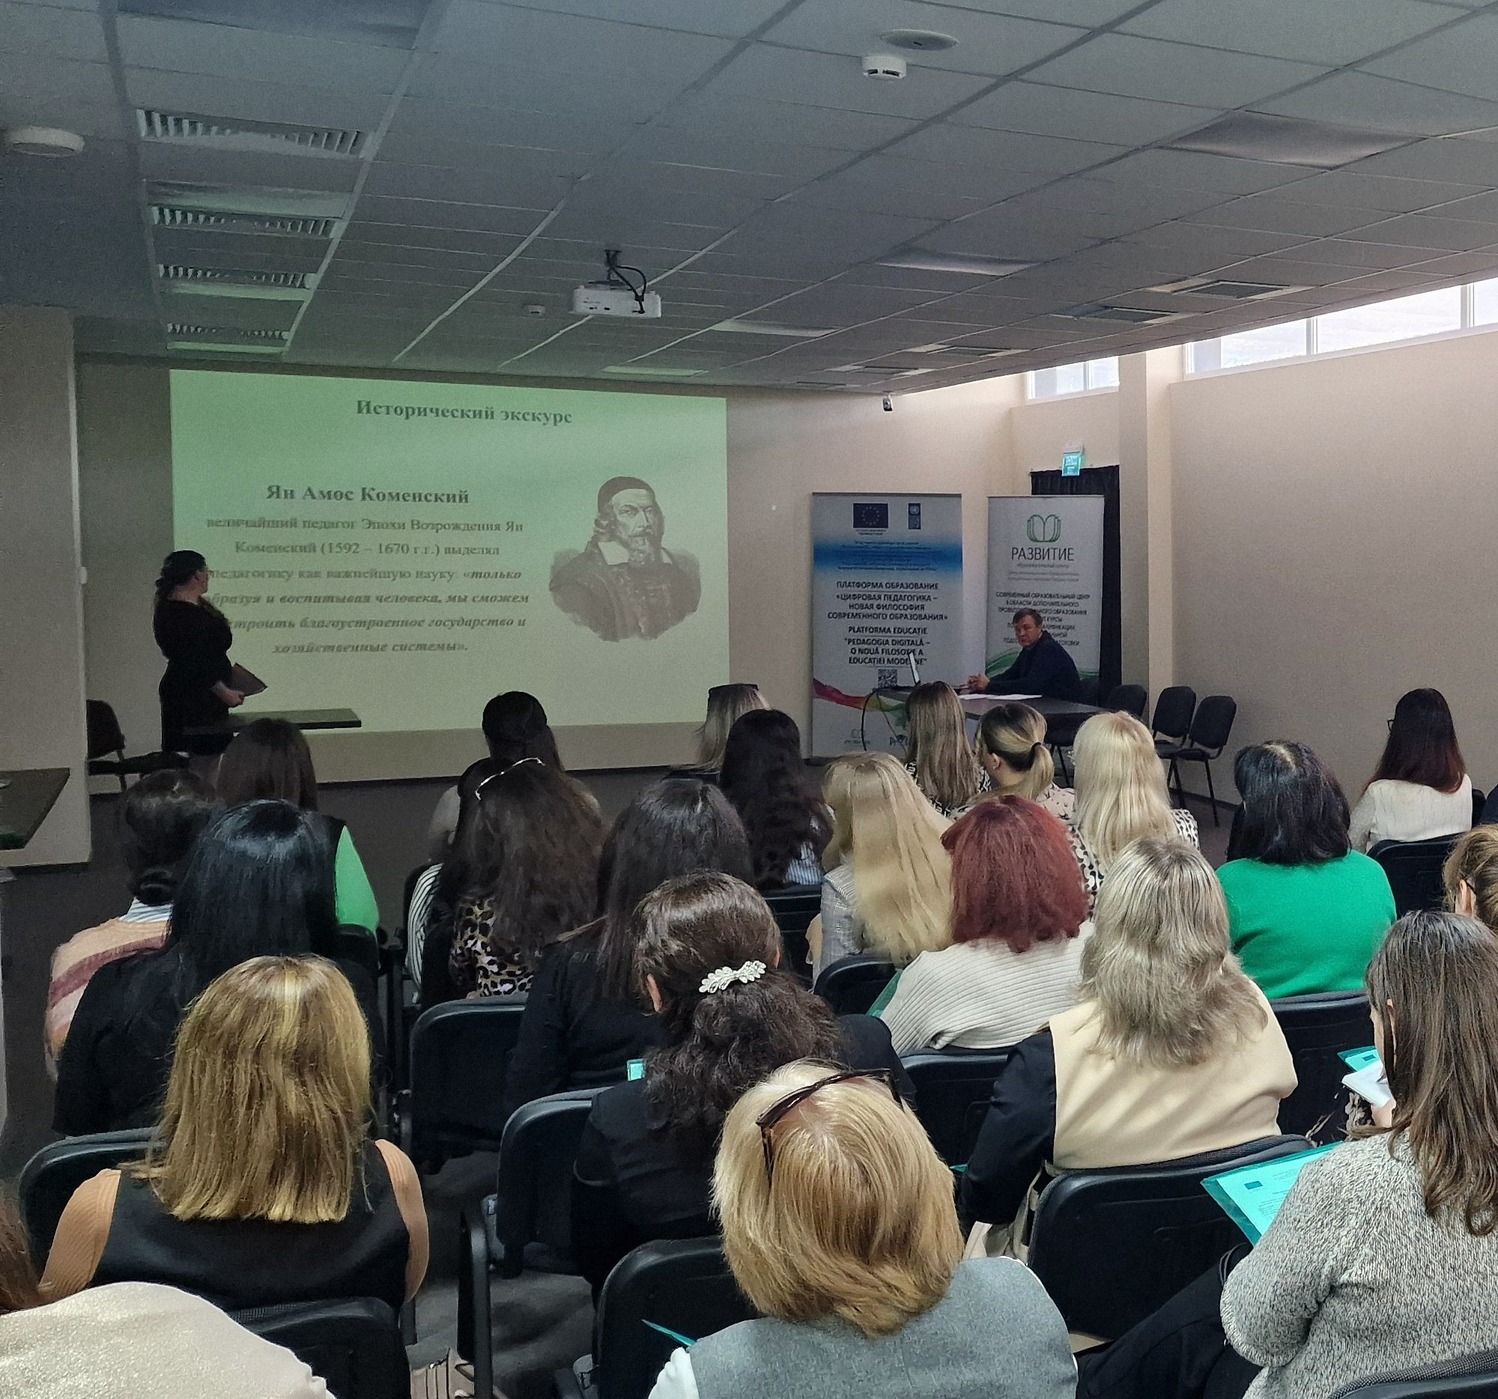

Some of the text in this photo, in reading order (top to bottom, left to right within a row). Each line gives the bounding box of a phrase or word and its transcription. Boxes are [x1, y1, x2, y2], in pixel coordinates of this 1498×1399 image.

[356, 400, 572, 426] Исторический экскурс
[265, 485, 470, 503] Ян Амос Коменский
[206, 517, 523, 533] величайший педагог Эпохи Возрождения Ян
[234, 541, 318, 554] Коменский
[320, 542, 360, 556] (1592
[378, 543, 410, 555] 1670
[444, 545, 500, 556] выделял
[1011, 547, 1075, 561] РАЗВИТИЕ
[298, 570, 322, 579] как
[326, 568, 411, 582] важнейшую
[836, 581, 939, 590] ПЛАТФОРМА ОБРАЗОВАНИЕ
[265, 595, 275, 603] и
[279, 594, 371, 604] воспитывая
[445, 594, 468, 603] мы
[472, 594, 529, 603] сможем
[883, 594, 932, 602] ПЕДАГОГИКА
[300, 617, 426, 631] благоустроенное
[428, 616, 514, 630] государство
[517, 618, 526, 627] и
[848, 626, 892, 634] PLATFORMA
[271, 641, 388, 654] хозяйственные
[887, 657, 928, 665] MODENE"
